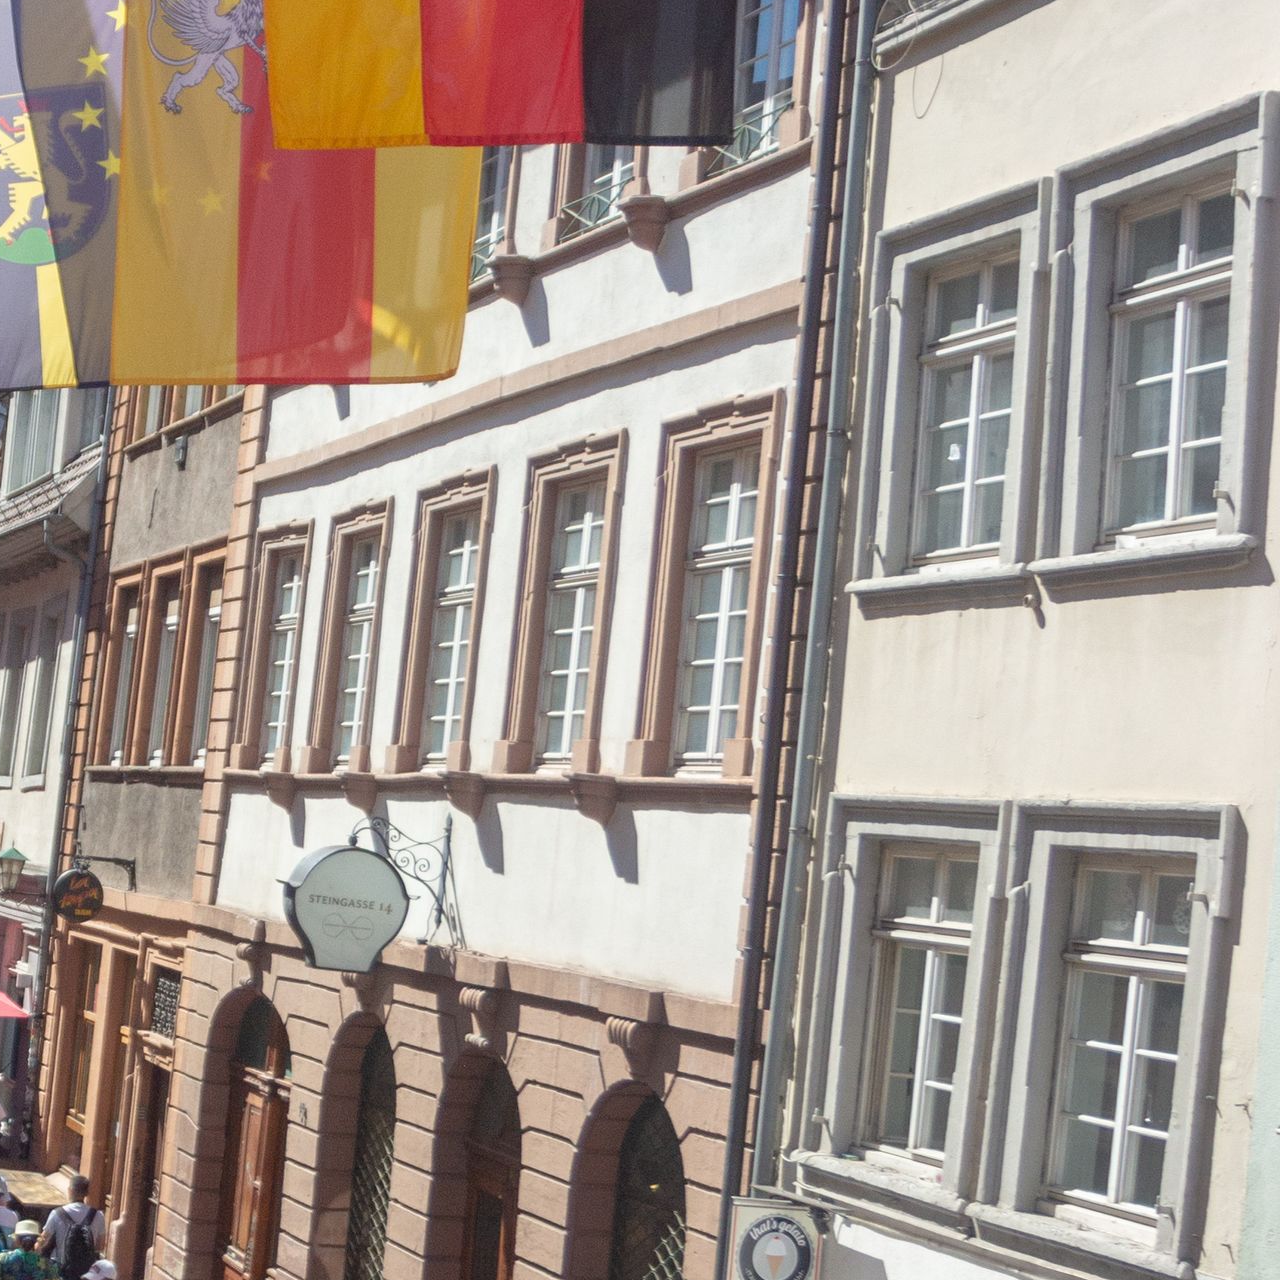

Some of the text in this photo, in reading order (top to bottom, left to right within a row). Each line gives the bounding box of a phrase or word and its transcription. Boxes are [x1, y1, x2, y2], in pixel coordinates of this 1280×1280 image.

[308, 894, 393, 915] STEINGASSE 14
[749, 1218, 806, 1247] that's gelato
